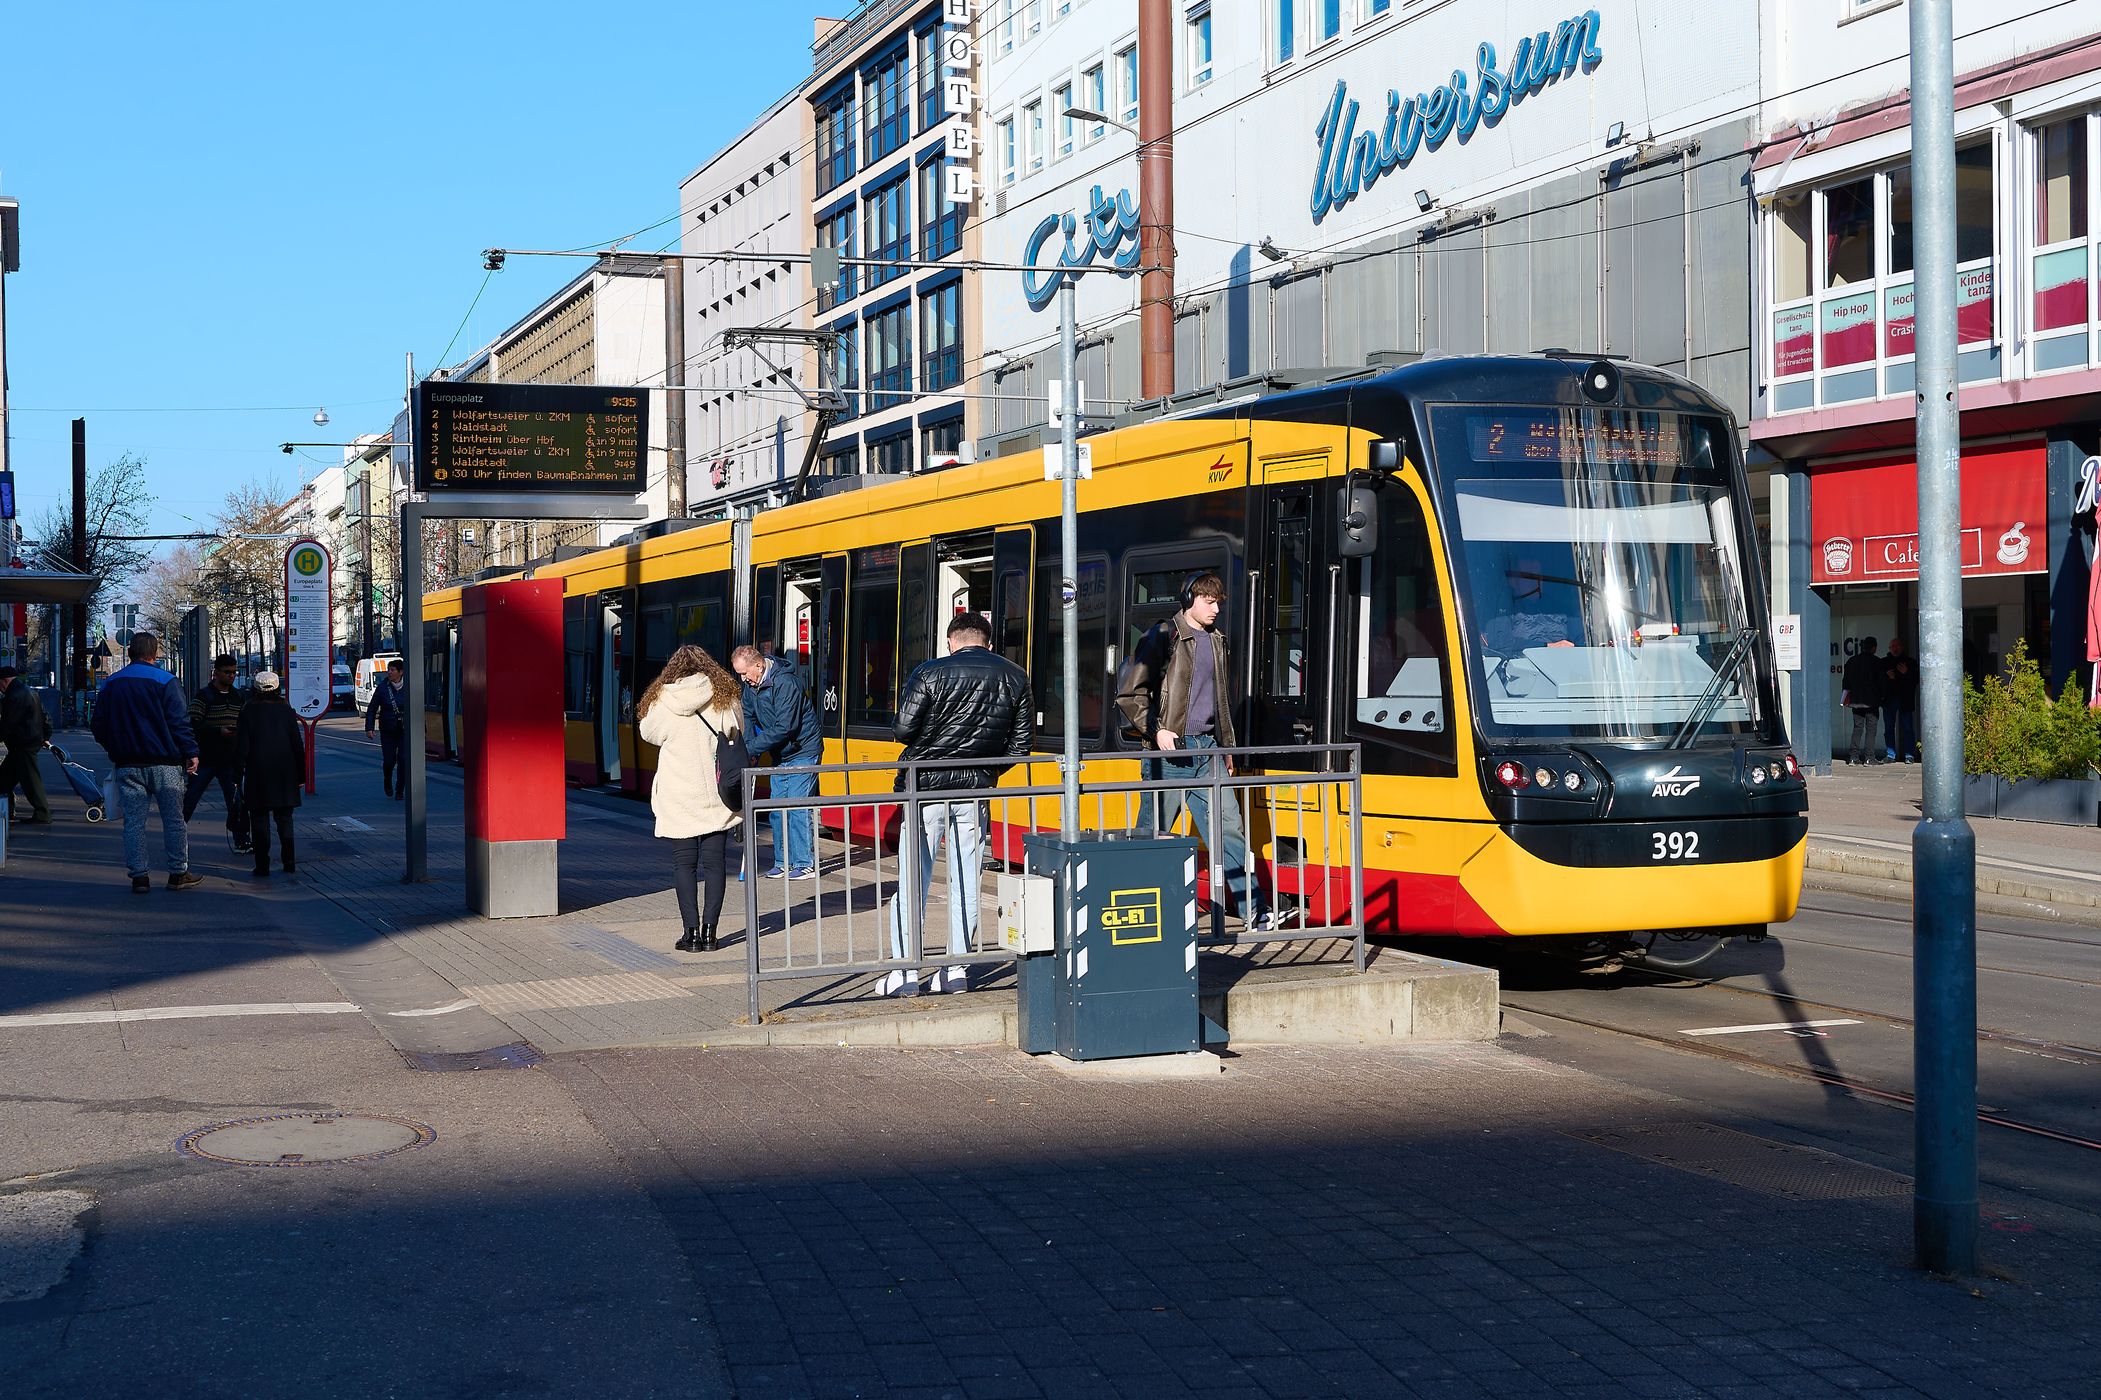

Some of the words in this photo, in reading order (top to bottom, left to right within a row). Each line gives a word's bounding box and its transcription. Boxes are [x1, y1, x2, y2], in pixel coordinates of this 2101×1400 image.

[948, 0, 969, 195] HOTEL
[1311, 9, 1603, 218] Universum
[1960, 271, 1991, 288] Kinde
[1967, 284, 1992, 298] tanz
[1892, 292, 1915, 306] Hoch
[1833, 306, 1848, 318] Hip
[1850, 303, 1868, 315] Hop
[1789, 324, 1802, 332] tanz
[431, 392, 483, 404] Europaplatz
[611, 396, 637, 408] 9:35
[432, 409, 439, 419] 2
[452, 410, 529, 422] Wolfartsweier
[549, 412, 571, 422] ZKM
[604, 414, 638, 424] sofort
[432, 421, 439, 431] 4
[452, 421, 508, 433] Waldstadt
[604, 425, 638, 436] sofort
[431, 433, 439, 443] 3
[452, 433, 502, 443] Rintheim
[506, 434, 532, 444] über
[536, 435, 555, 446] Hbf
[596, 436, 607, 446] in
[609, 436, 616, 446] 9
[618, 438, 638, 446] min
[1489, 423, 1505, 455] 2
[431, 445, 439, 455] 2
[452, 445, 529, 457] Wolfartsweier
[548, 447, 570, 457] ZKM
[596, 447, 607, 458] in
[609, 448, 616, 458] 9
[618, 448, 638, 458] min
[431, 457, 438, 467] 4
[452, 457, 508, 468] Waldstadt
[613, 459, 636, 470] 9:49
[473, 469, 492, 479] Uhr
[498, 470, 532, 481] finden
[536, 470, 618, 482] Baumaßnahmen
[622, 472, 636, 481] im
[1208, 470, 1224, 484] KVV
[1884, 540, 1919, 564] Cafe
[1779, 624, 1795, 635] GBP
[1651, 783, 1681, 797] AVG
[1652, 831, 1700, 860] 392
